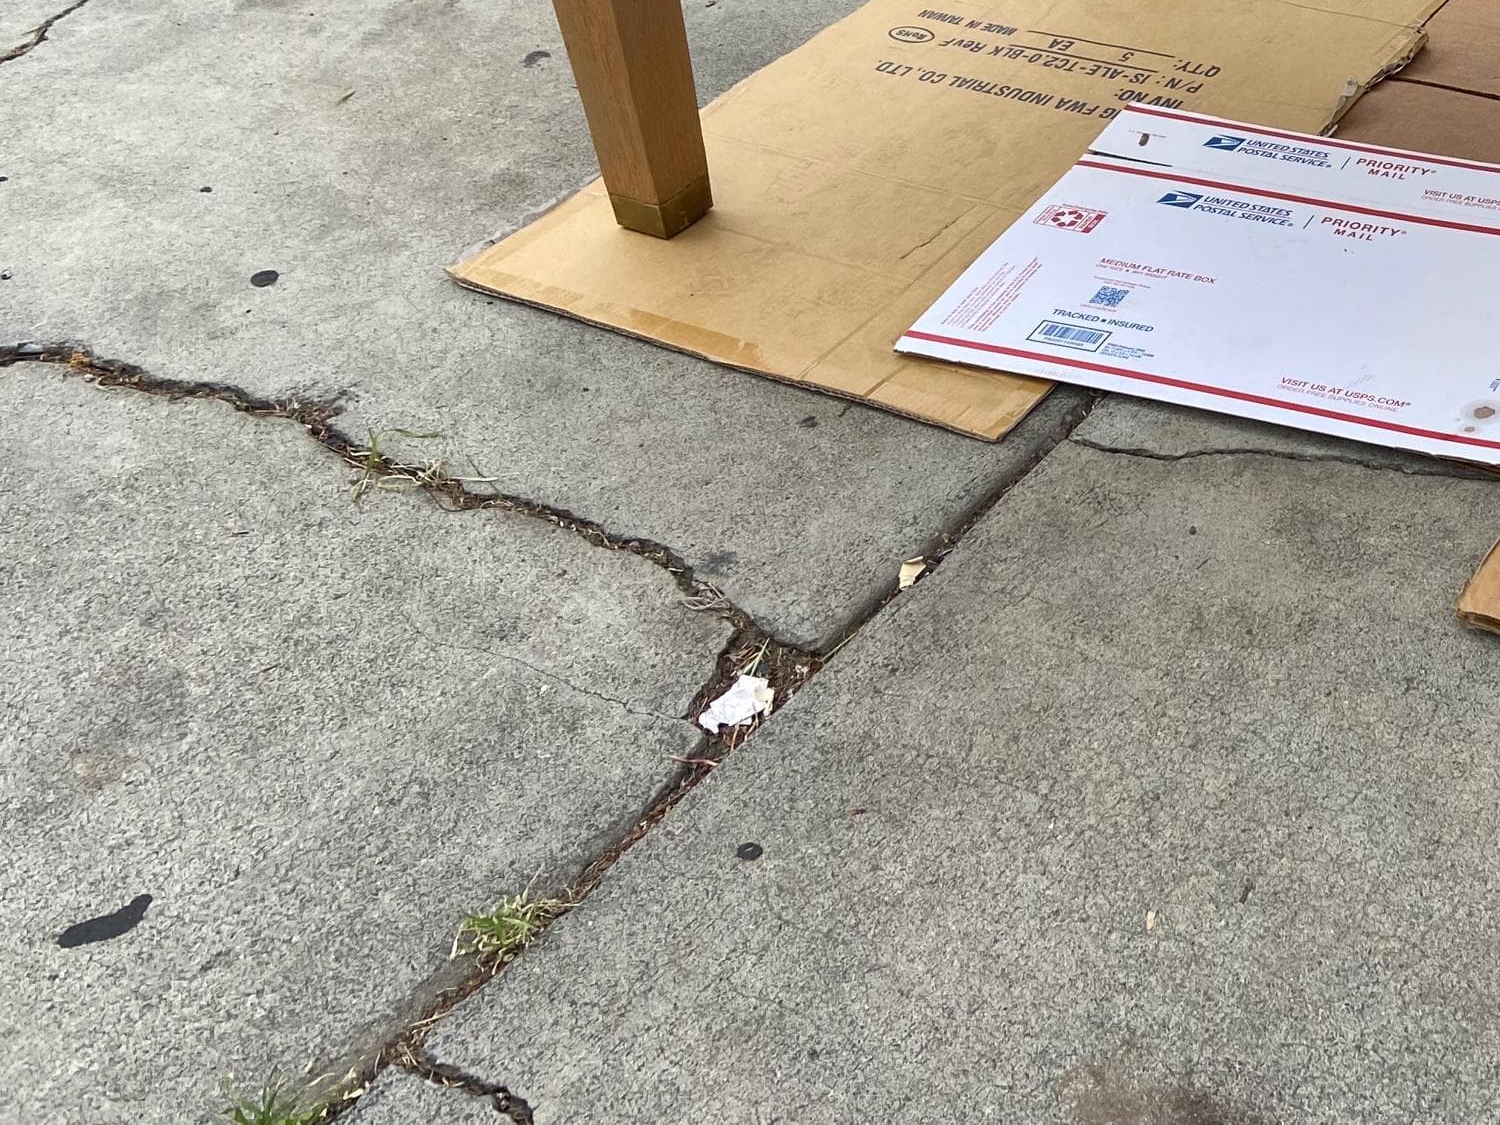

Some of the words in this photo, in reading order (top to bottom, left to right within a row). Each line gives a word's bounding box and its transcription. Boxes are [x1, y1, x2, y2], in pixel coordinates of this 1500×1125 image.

[917, 9, 964, 26] TAIWAN
[965, 20, 982, 29] IN
[980, 23, 1018, 36] MADE
[1048, 38, 1076, 52] EA
[1118, 51, 1135, 62] 5
[875, 59, 914, 77] LTD.
[948, 75, 1053, 106] INDUSTRIAL
[1054, 96, 1101, 116] FWA
[1236, 146, 1279, 161] POSTAL
[1245, 139, 1292, 153] UNITED
[1289, 145, 1330, 159] STATES
[1367, 168, 1406, 181] MAIL
[1424, 188, 1449, 198] VISIT
[1463, 195, 1478, 203] AT
[1192, 203, 1238, 219] POSTAL
[1203, 195, 1251, 210] UNITED
[1249, 203, 1294, 217] STATES
[1333, 228, 1374, 242] MAIL
[1100, 257, 1141, 271] MEDIUM
[1141, 265, 1168, 275] FLAT
[1166, 269, 1195, 280] RATE
[1193, 274, 1217, 285] BOX
[1052, 307, 1100, 323] TRACKED
[1107, 317, 1155, 333] INSURED
[1280, 376, 1310, 388] VISIT
[1310, 382, 1328, 392] US
[1327, 386, 1343, 395] AT
